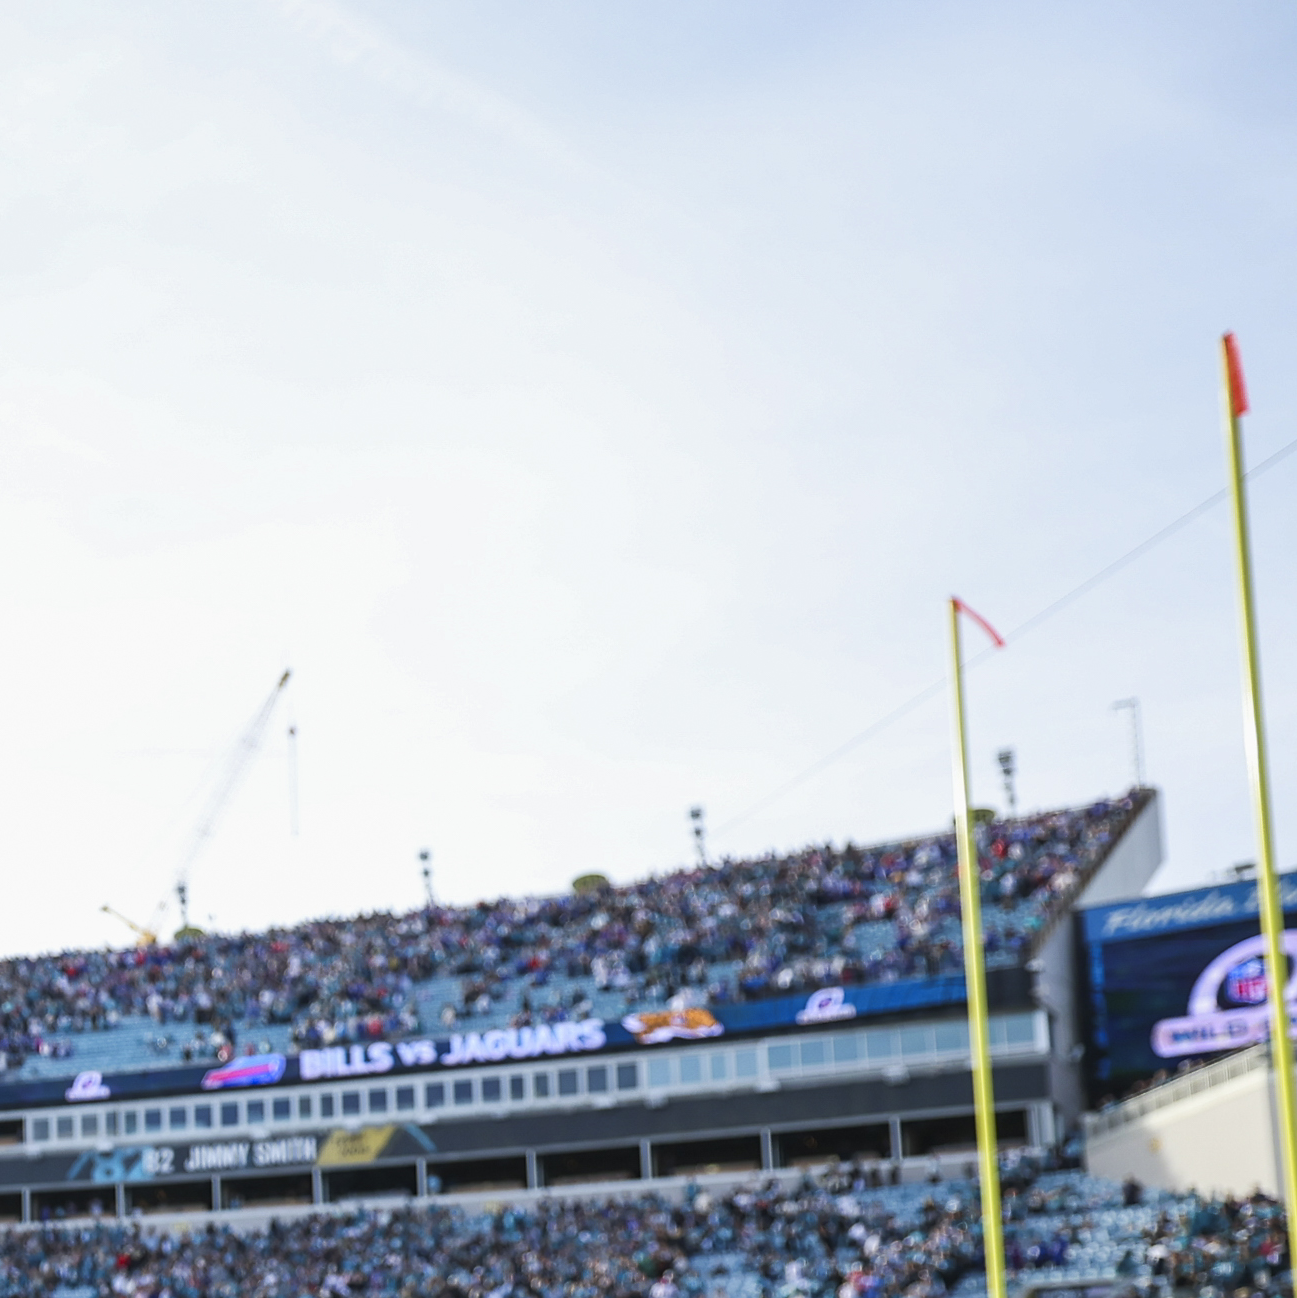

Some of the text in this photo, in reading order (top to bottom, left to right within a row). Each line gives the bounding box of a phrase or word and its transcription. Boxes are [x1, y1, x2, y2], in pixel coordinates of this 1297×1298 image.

[299, 1041, 396, 1080] BILLS
[440, 1017, 606, 1066] JAGUARS
[185, 1142, 250, 1172] JIMMY
[251, 1136, 318, 1168] SMITH
